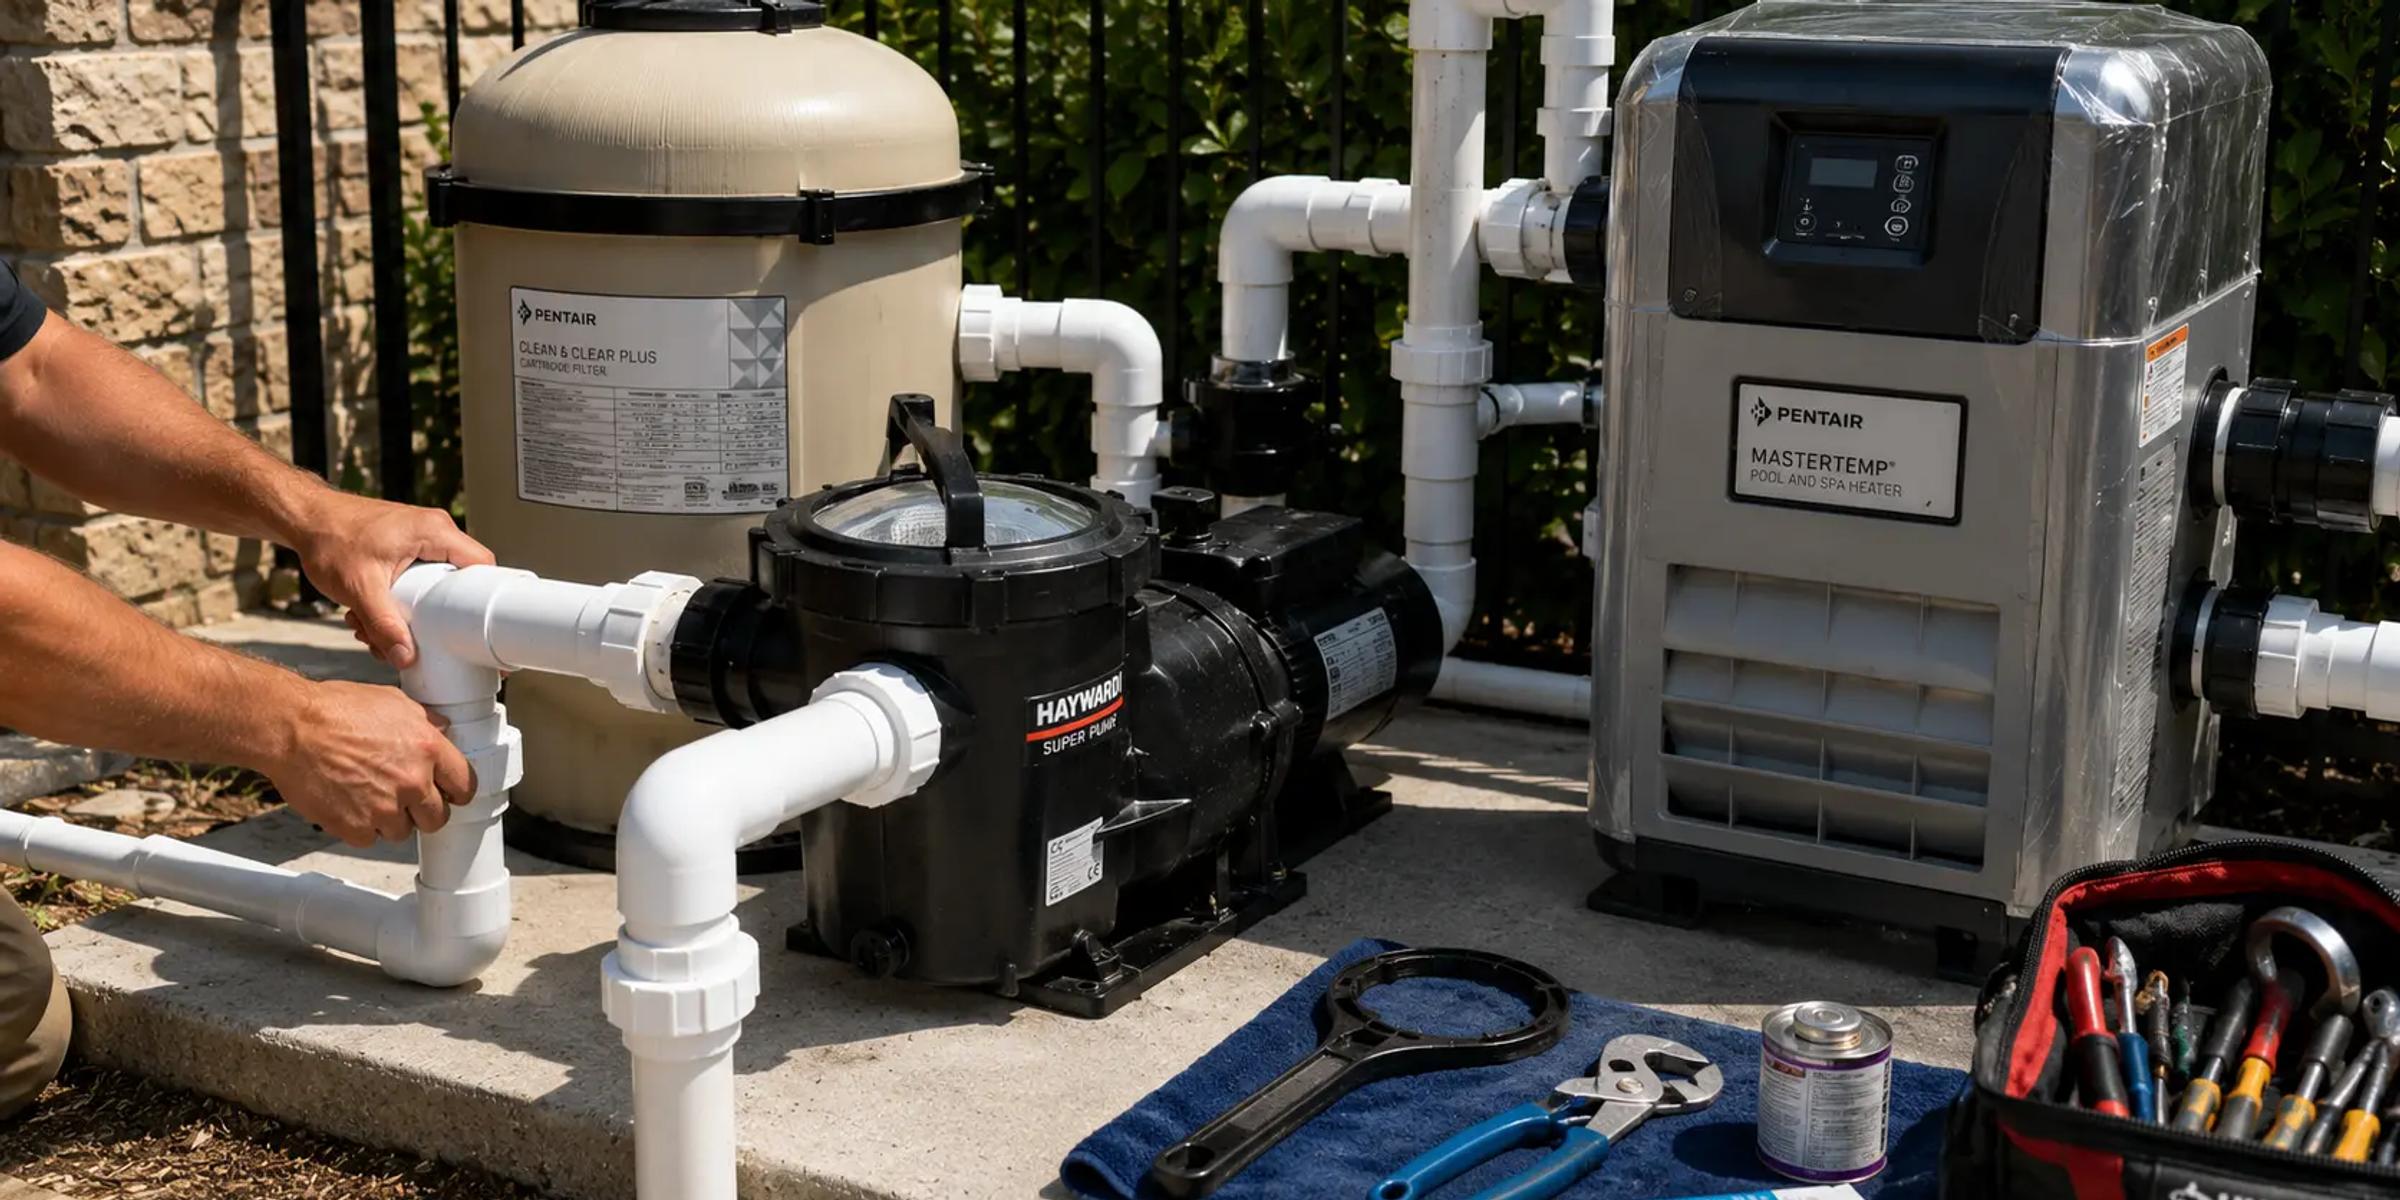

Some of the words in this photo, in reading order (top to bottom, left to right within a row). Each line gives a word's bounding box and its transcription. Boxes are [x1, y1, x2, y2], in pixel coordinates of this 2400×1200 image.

[535, 308, 597, 326] PENTAIR
[519, 340, 557, 357] CLEAN
[571, 346, 616, 361] CLEAR
[620, 349, 658, 364] PLUS
[572, 363, 608, 377] FILTER
[1777, 406, 1864, 430] PENTAIR
[1750, 468, 1784, 484] POOL
[1787, 473, 1817, 488] AND
[1820, 476, 1846, 491] SPA
[1849, 480, 1903, 497] HEATER
[1042, 730, 1086, 756] SUPER
